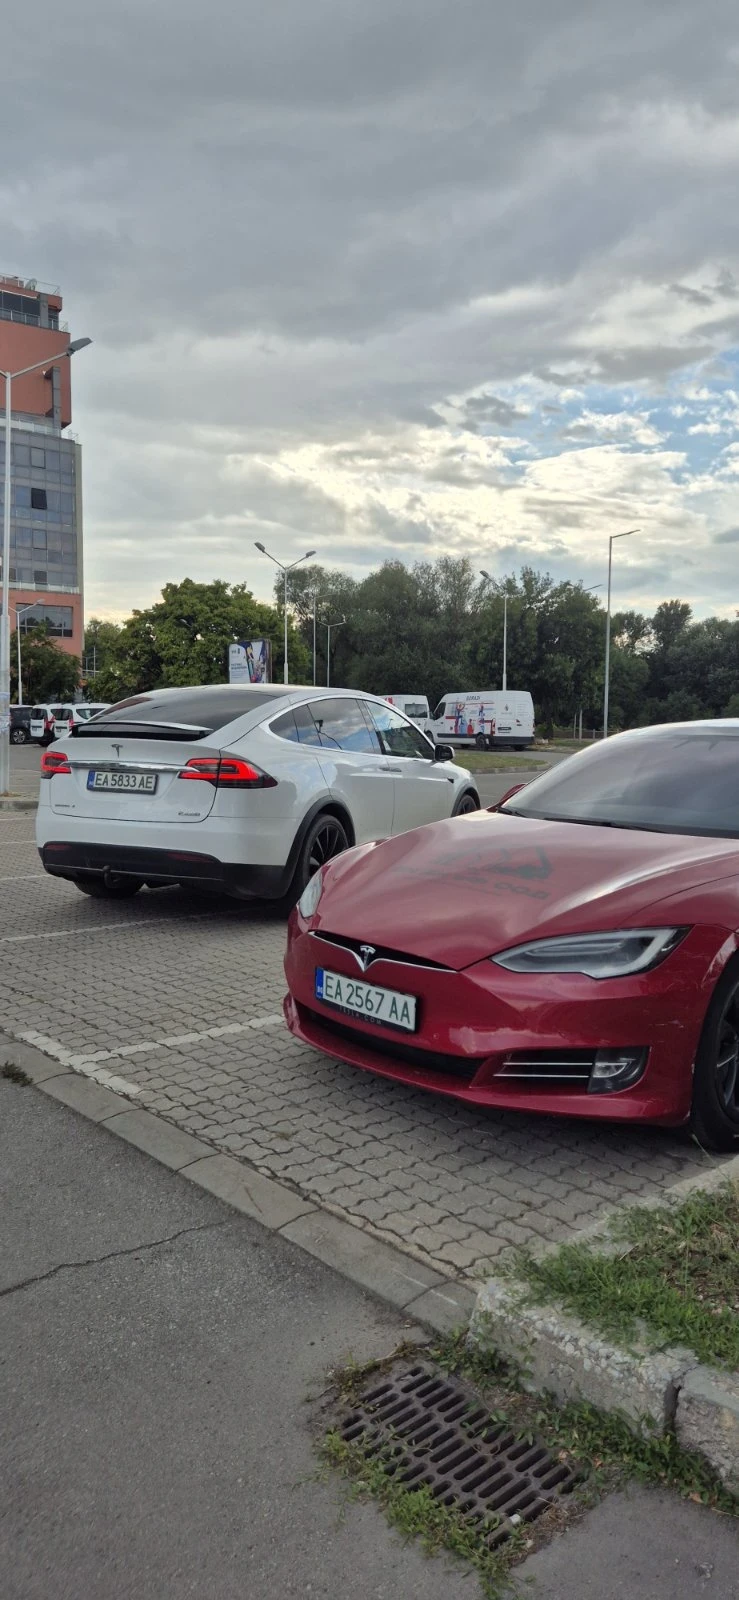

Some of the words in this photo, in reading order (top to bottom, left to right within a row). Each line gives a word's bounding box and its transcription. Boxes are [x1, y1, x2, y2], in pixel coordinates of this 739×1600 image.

[95, 773, 109, 786] EA
[111, 774, 137, 788] 5833
[138, 776, 153, 789] AE
[325, 975, 343, 1002] EA
[346, 983, 385, 1014] 2567
[389, 996, 410, 1024] AA
